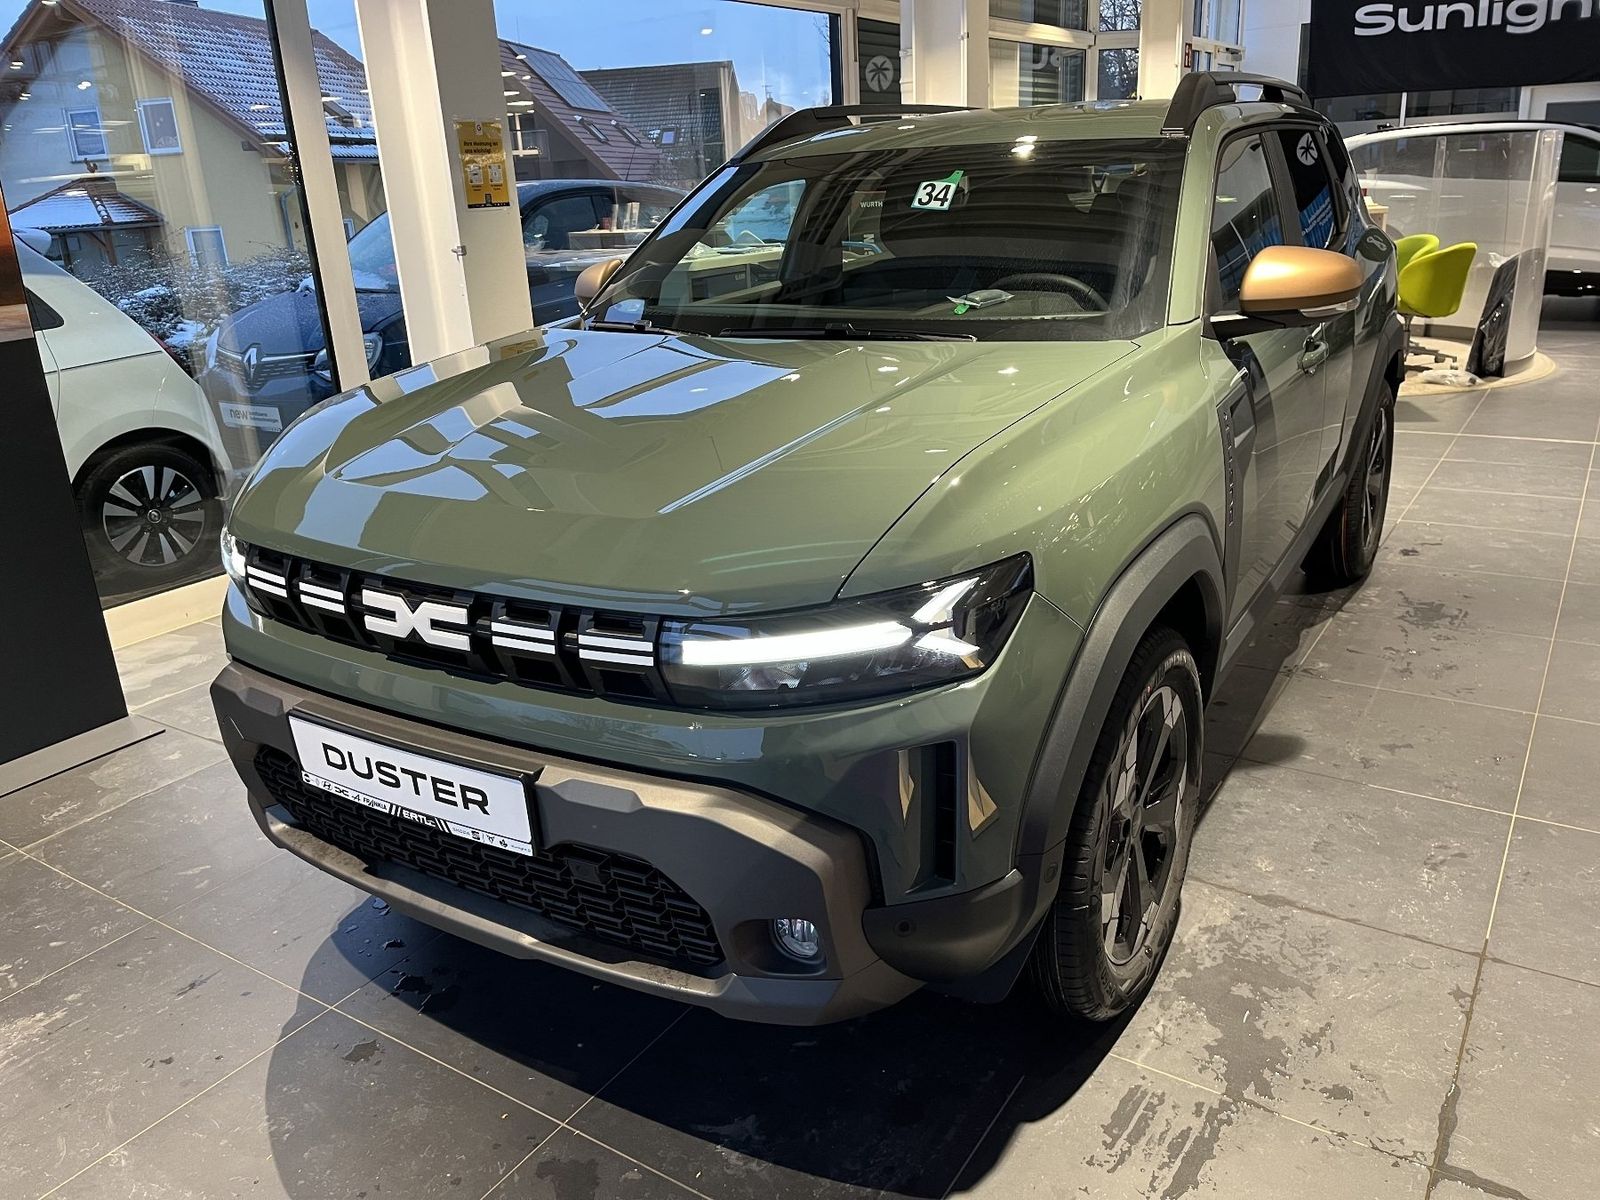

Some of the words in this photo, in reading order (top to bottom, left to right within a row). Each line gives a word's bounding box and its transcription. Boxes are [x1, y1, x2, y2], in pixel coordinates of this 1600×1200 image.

[1354, 0, 1600, 36] Sunligh
[917, 183, 951, 207] 34
[229, 408, 248, 420] new
[321, 742, 491, 815] DUSTER
